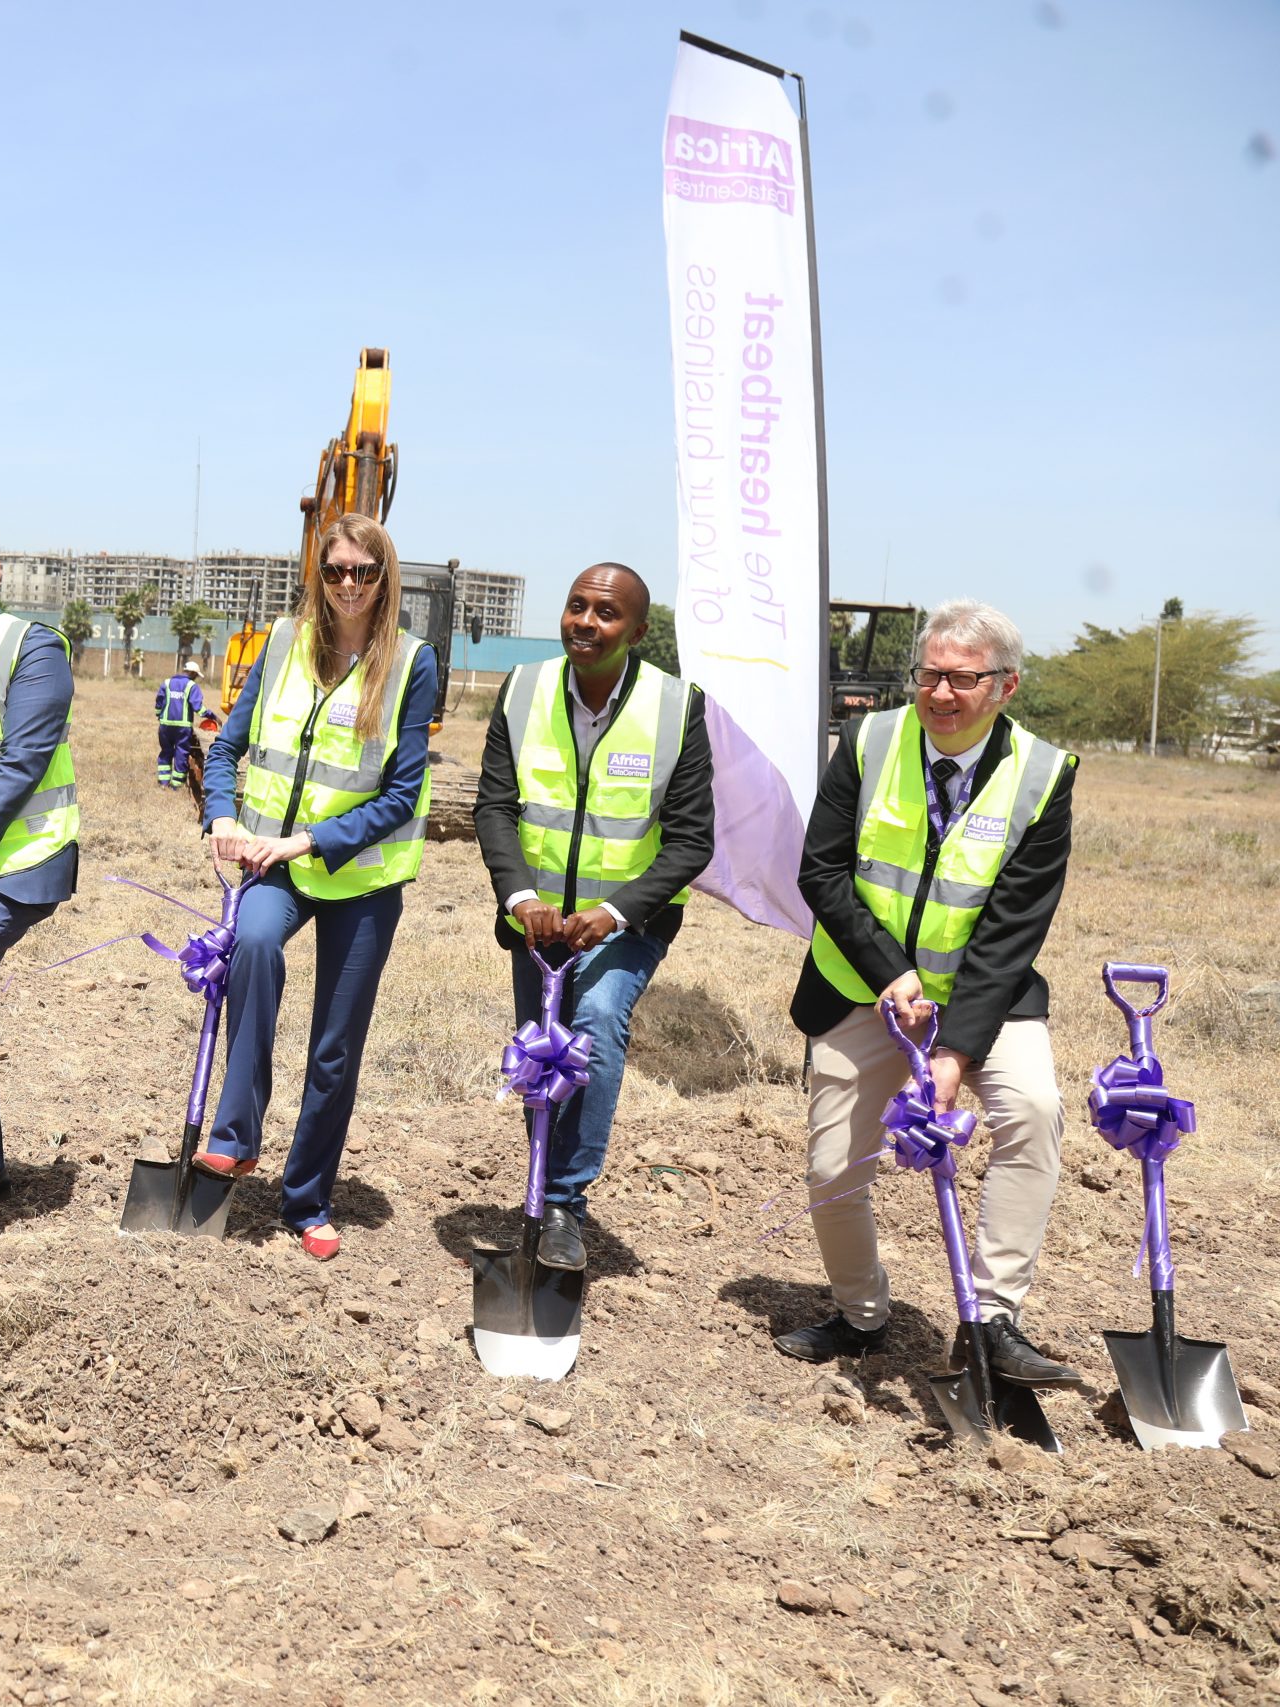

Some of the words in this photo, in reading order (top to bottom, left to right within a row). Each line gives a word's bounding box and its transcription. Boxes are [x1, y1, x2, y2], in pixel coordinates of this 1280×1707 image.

[331, 703, 357, 718] Afric
[610, 754, 648, 767] Africa
[967, 815, 1006, 831] Africa
